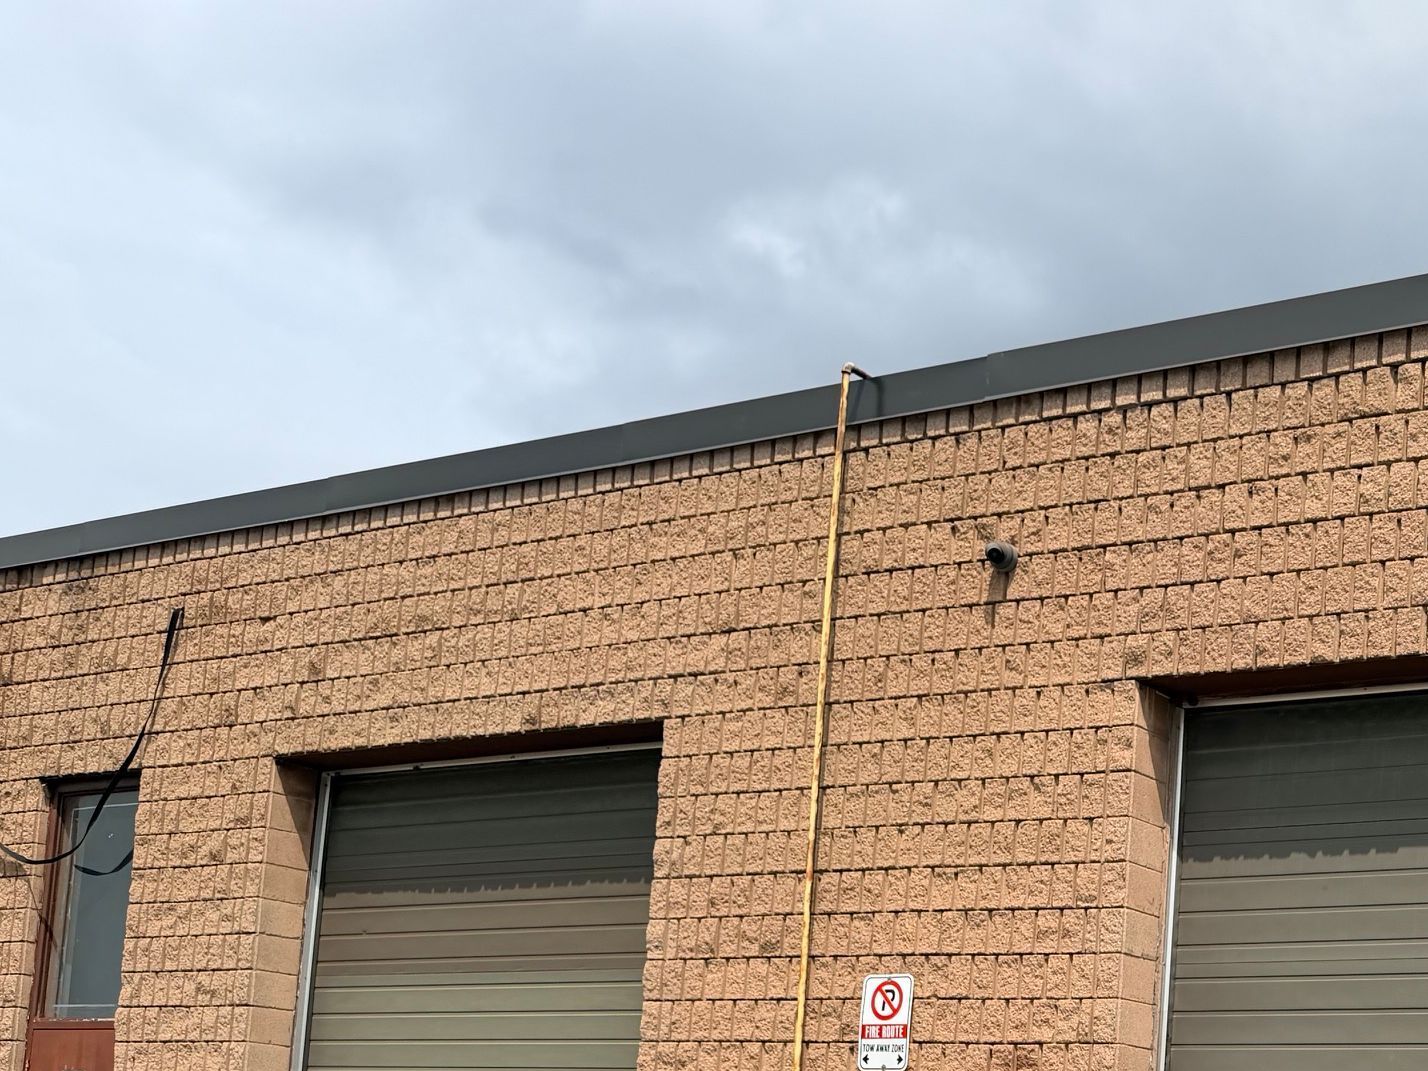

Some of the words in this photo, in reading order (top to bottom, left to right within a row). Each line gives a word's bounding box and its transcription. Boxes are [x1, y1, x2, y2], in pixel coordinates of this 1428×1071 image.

[864, 1025, 880, 1038] FIRE
[881, 1025, 905, 1038] ROUTE
[863, 1043, 876, 1053] TOW
[876, 1043, 891, 1053] AWAY
[891, 1043, 905, 1053] ZONE
